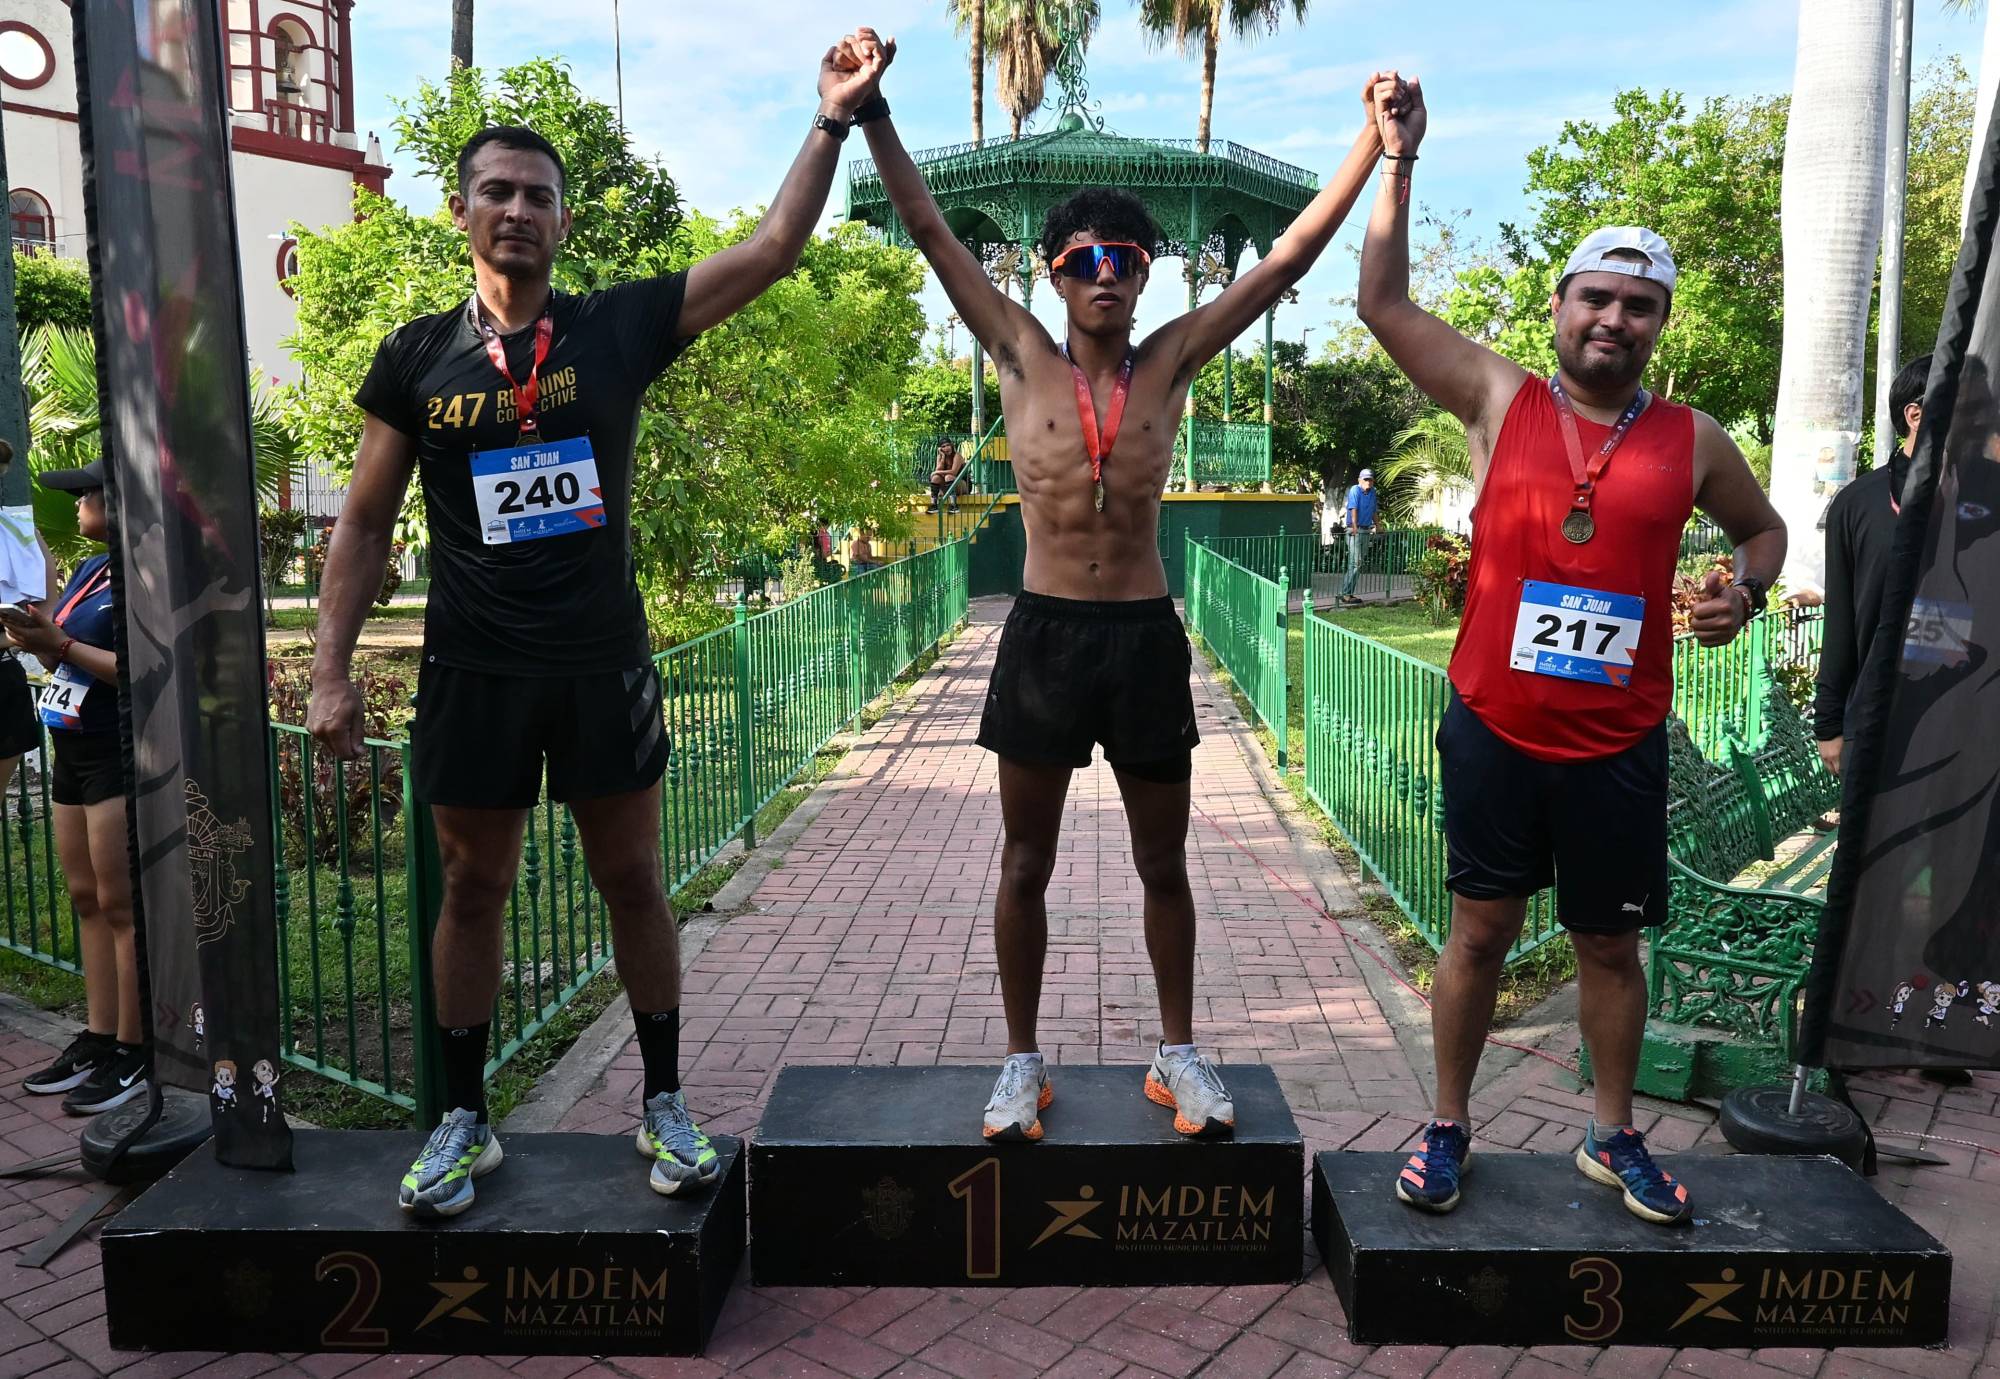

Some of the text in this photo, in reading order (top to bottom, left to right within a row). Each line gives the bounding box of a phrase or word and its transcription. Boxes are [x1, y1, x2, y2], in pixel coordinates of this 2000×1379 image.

[497, 366, 577, 409] RUNING
[427, 392, 486, 429] 247
[511, 451, 560, 471] SAN JUAN
[494, 472, 580, 515] 240
[1560, 594, 1612, 614] SAN JUAN
[1531, 613, 1621, 655] 217
[1119, 1184, 1275, 1217] IMDEM
[947, 1156, 1001, 1280] 1
[1116, 1216, 1271, 1241] MAZATLÁN
[315, 1250, 389, 1346] 2
[505, 1266, 668, 1300] IMDEM
[1564, 1256, 1624, 1341] 3
[1759, 1268, 1916, 1300] IMDEM
[504, 1300, 666, 1325] MAZATLÁN
[1755, 1300, 1910, 1324] MAZATLÁN
